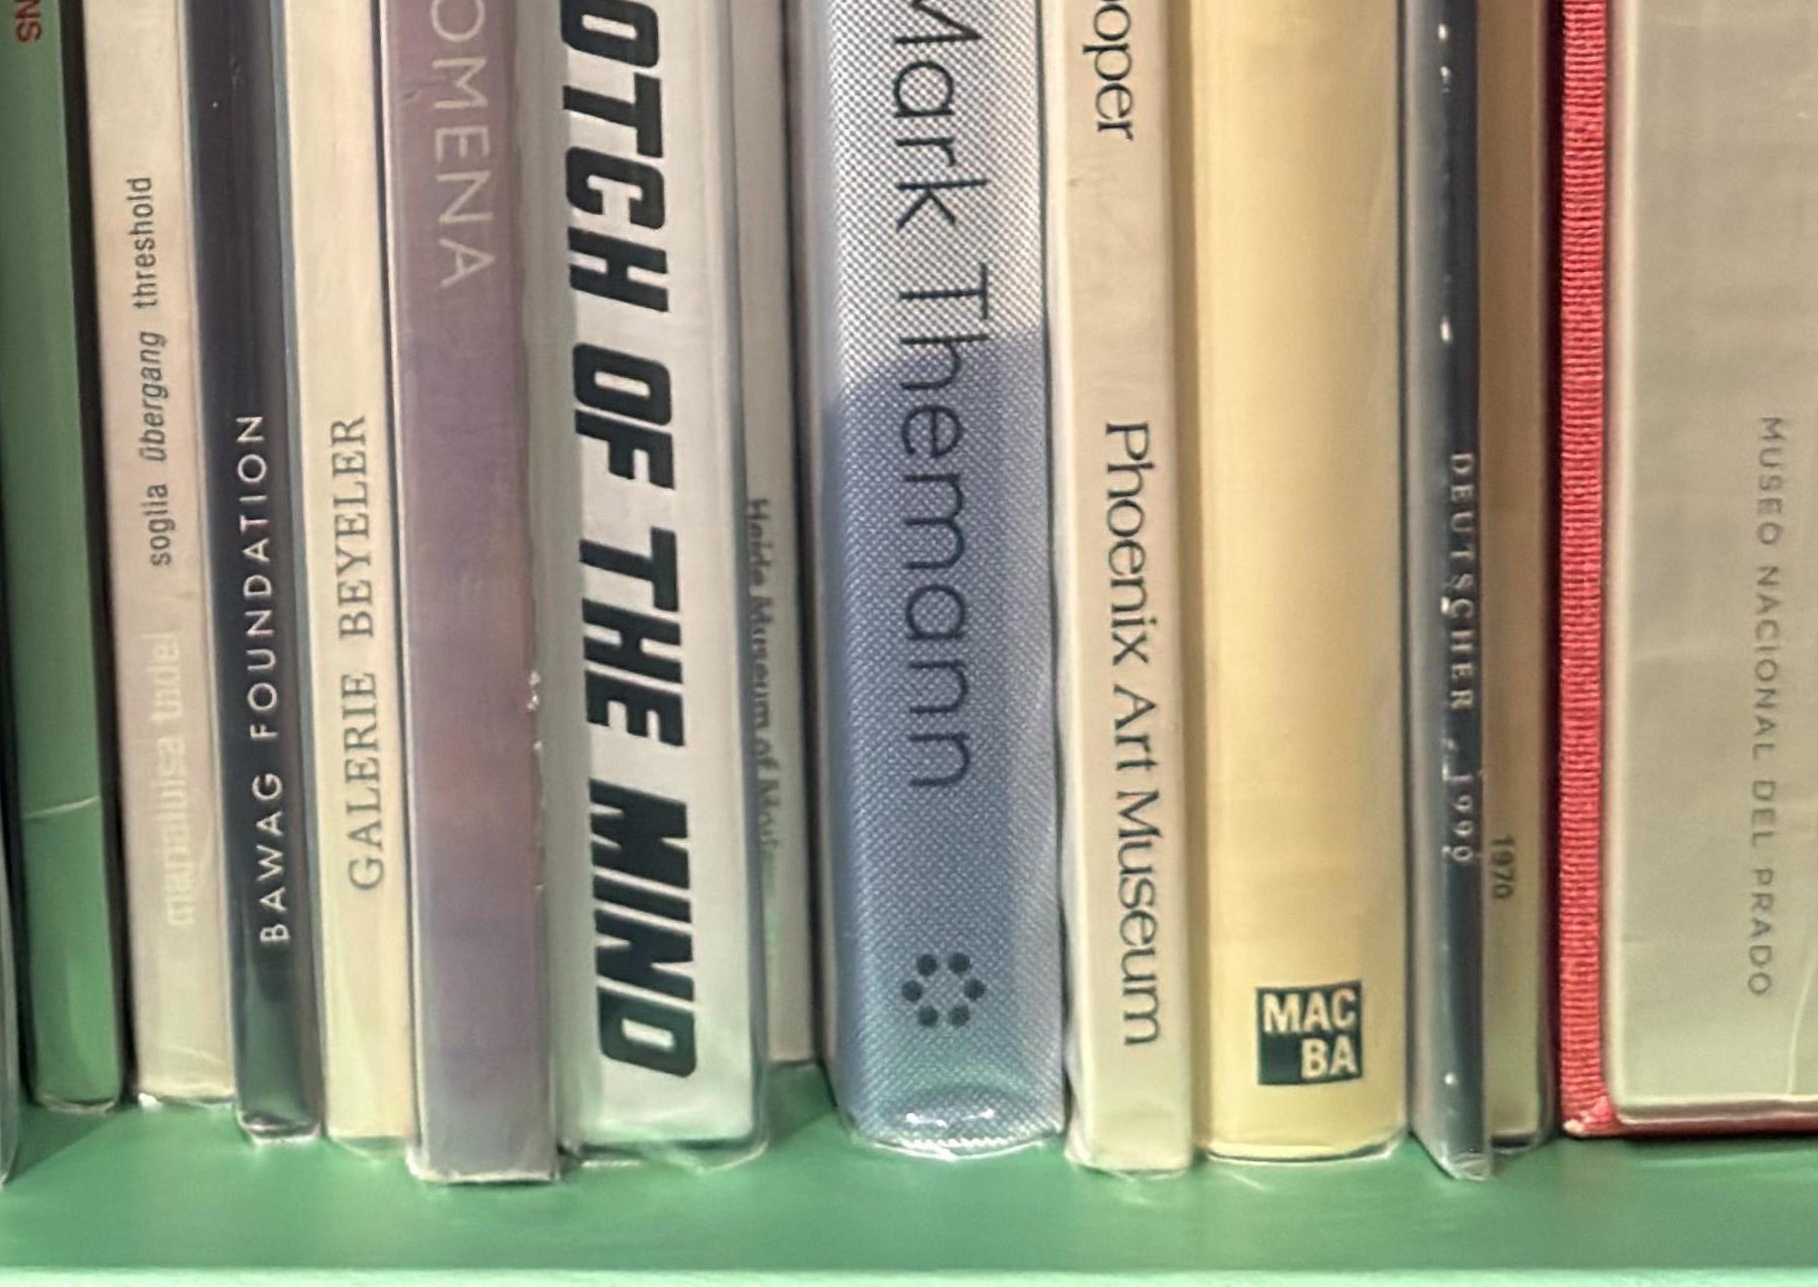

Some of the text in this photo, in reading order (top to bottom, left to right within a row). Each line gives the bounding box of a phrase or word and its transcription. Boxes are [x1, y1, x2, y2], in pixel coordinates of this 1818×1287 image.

[125, 175, 172, 568] soglia übergang threshold
[570, 341, 675, 493] OF
[331, 412, 386, 894] GALERIE BEYELER
[577, 528, 687, 749] THE
[896, 261, 993, 791] Themann
[1448, 452, 1476, 713] DEUTSCHER
[235, 414, 292, 947] BAWAG FOUNDATION
[1102, 419, 1165, 1048] Phoenix Art Museum
[1745, 415, 1785, 998] MUSEO NACIONAL DEL PRADO
[588, 776, 698, 1079] MIND
[1261, 987, 1356, 1035] MAC
[1491, 836, 1517, 901] 1970
[1298, 1035, 1360, 1079] BA
